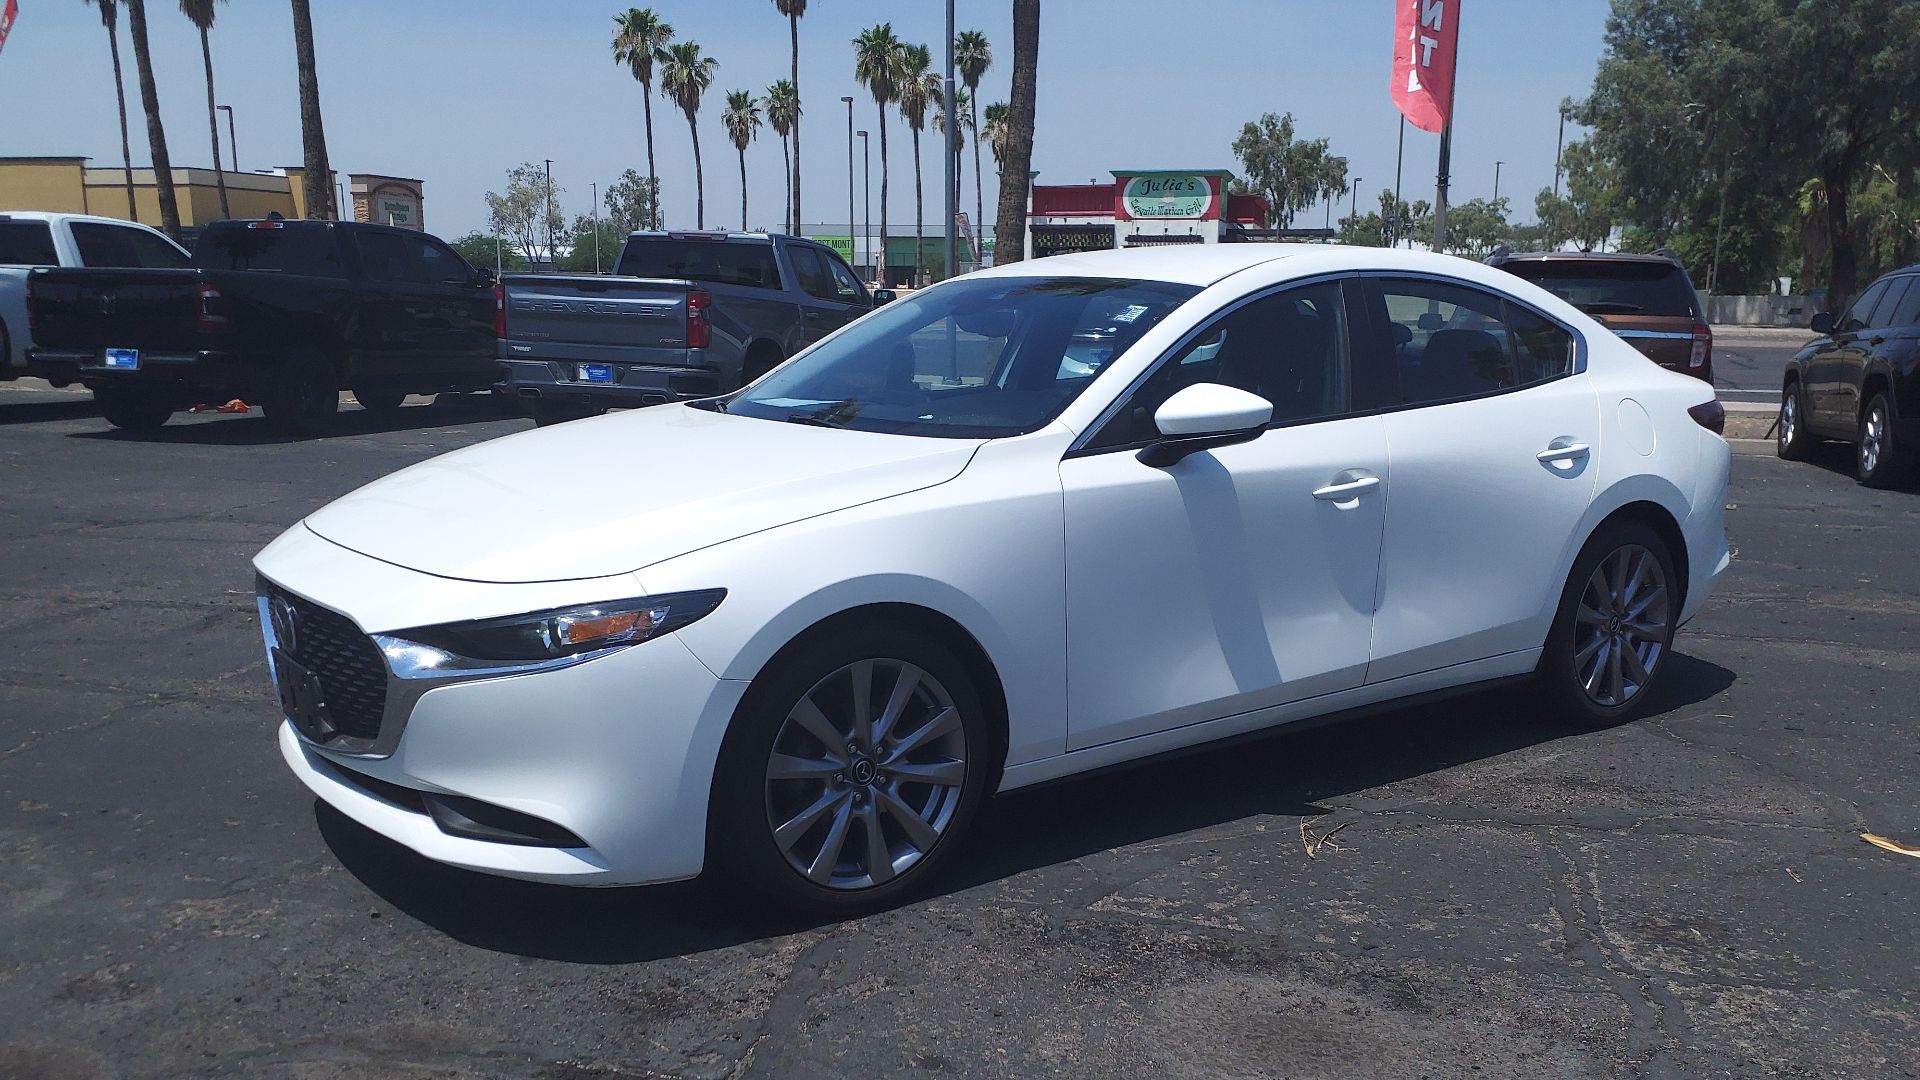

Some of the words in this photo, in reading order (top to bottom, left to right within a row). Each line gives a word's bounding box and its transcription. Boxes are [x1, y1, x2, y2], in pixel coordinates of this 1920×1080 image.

[1140, 178, 1195, 195] Julia's
[1186, 198, 1202, 216] Grill
[831, 239, 852, 249] MONT
[514, 300, 673, 317] CHEVROLET
